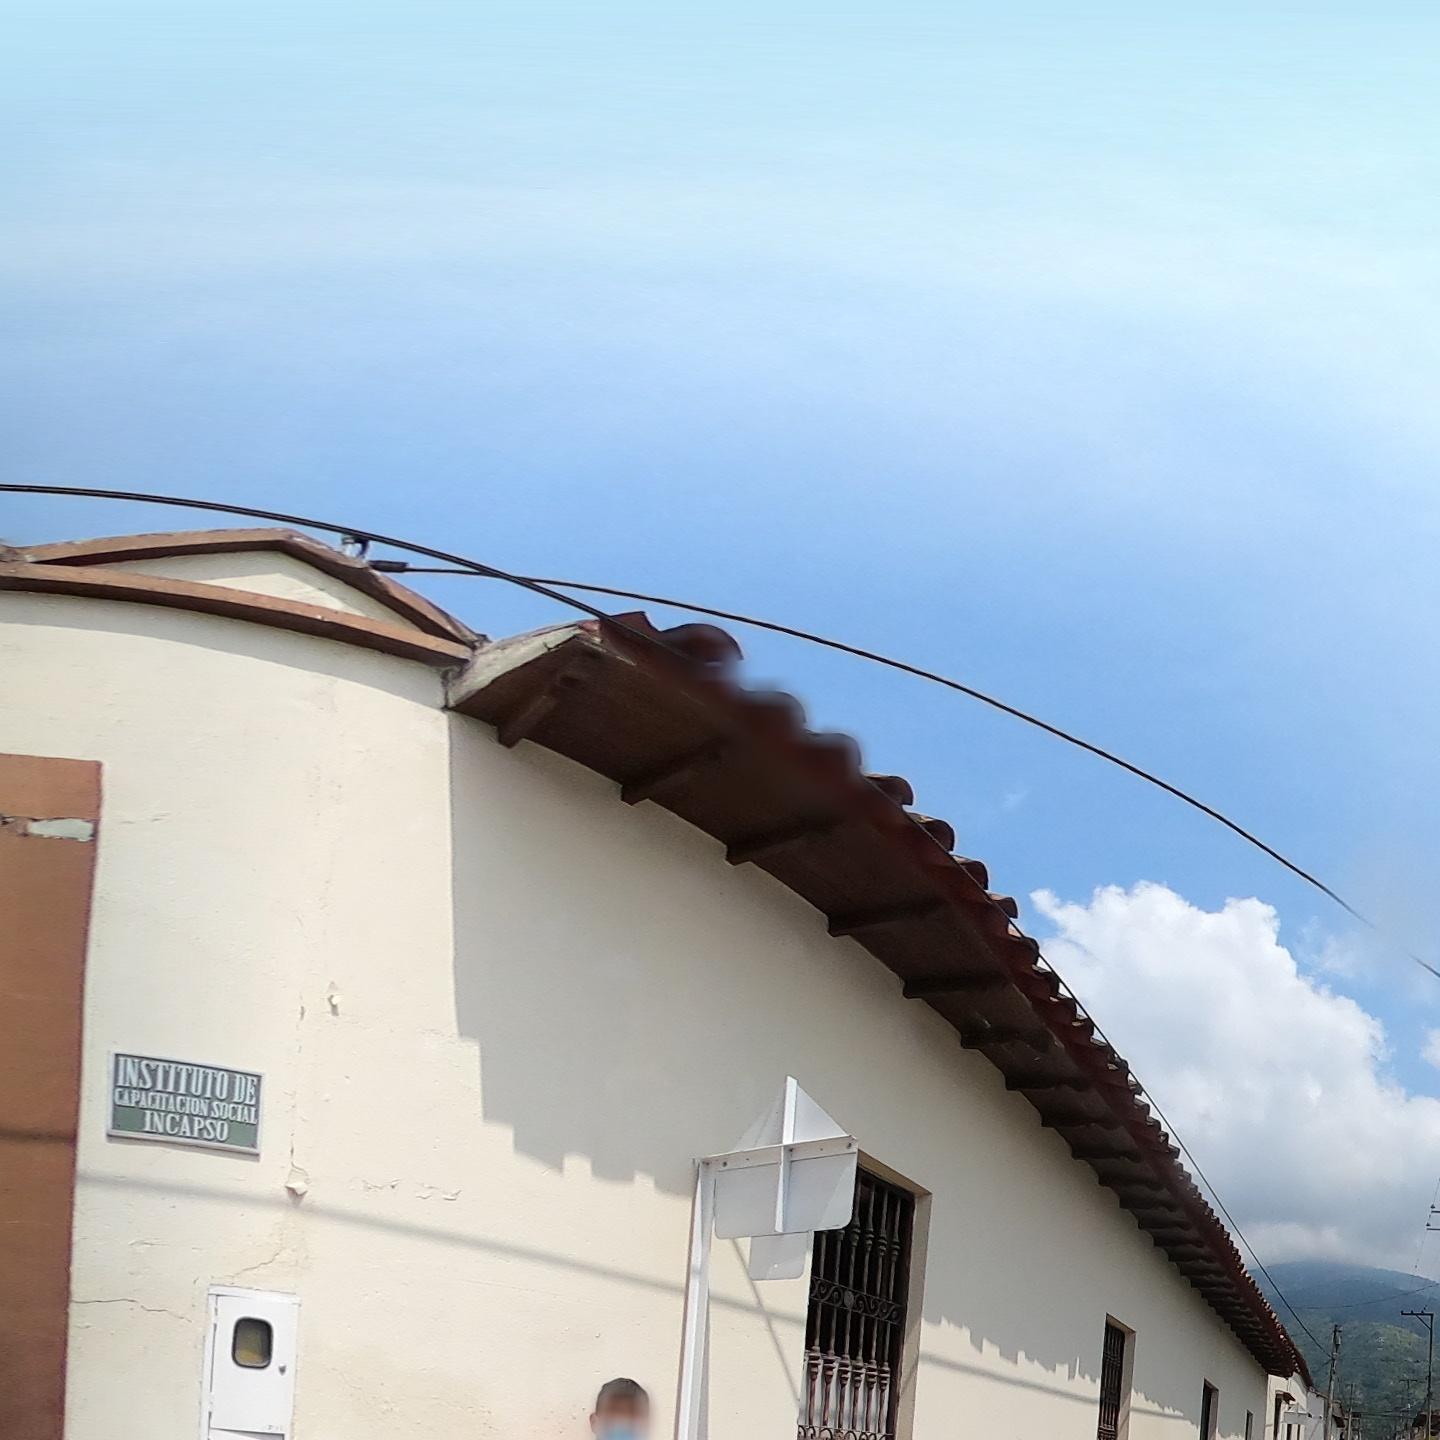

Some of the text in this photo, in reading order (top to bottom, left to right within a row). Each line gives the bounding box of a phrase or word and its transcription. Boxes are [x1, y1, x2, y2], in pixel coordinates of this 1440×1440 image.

[116, 1057, 257, 1105] INSTITUTO DE
[114, 1088, 258, 1125] CAPACITACION SOCIAL
[144, 1110, 229, 1142] INCAPSO
